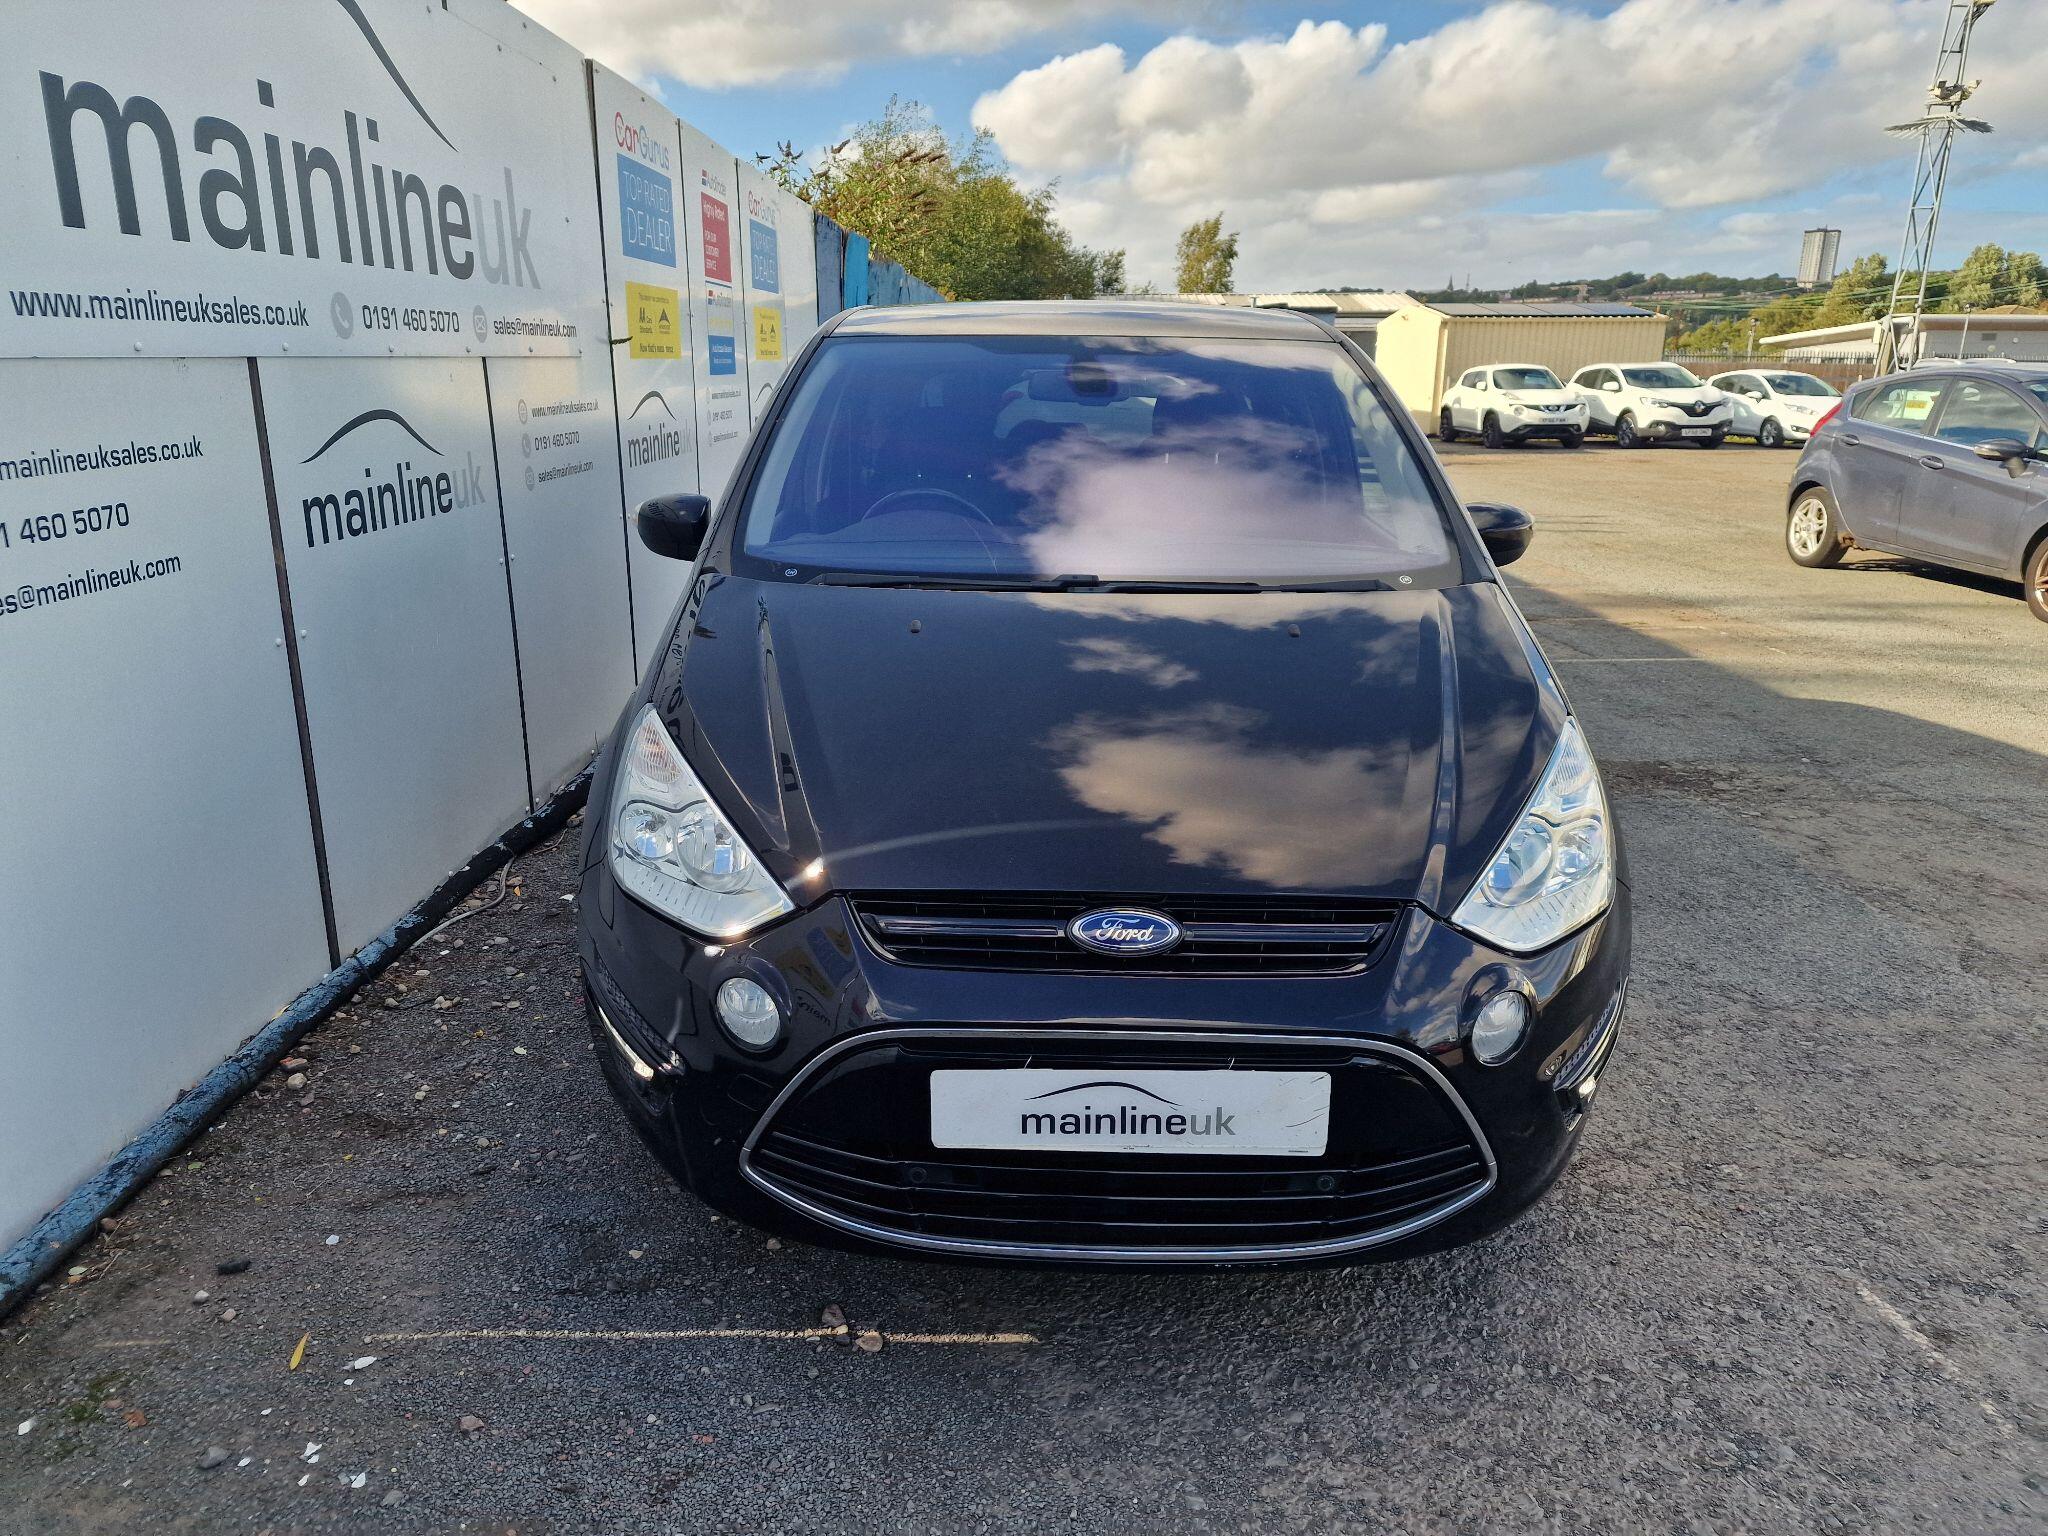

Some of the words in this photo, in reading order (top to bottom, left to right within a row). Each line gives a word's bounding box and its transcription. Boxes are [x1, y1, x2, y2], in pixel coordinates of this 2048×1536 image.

[38, 69, 542, 290] mainlineuk
[623, 171, 642, 201] TOP
[644, 180, 670, 214] RATED
[627, 206, 673, 254] DEALER
[9, 287, 310, 327] www.mainlineuksales.co.uk
[361, 304, 399, 331] 0191
[402, 307, 428, 332] 460
[429, 310, 461, 333] 5070
[493, 315, 578, 338] sales@mainlineuk.com
[302, 450, 486, 548] mainlineuk
[20, 513, 68, 544] 460
[72, 502, 130, 535] 5070
[1095, 917, 1155, 942] Ford
[1021, 1105, 1236, 1136] mainlineuk
